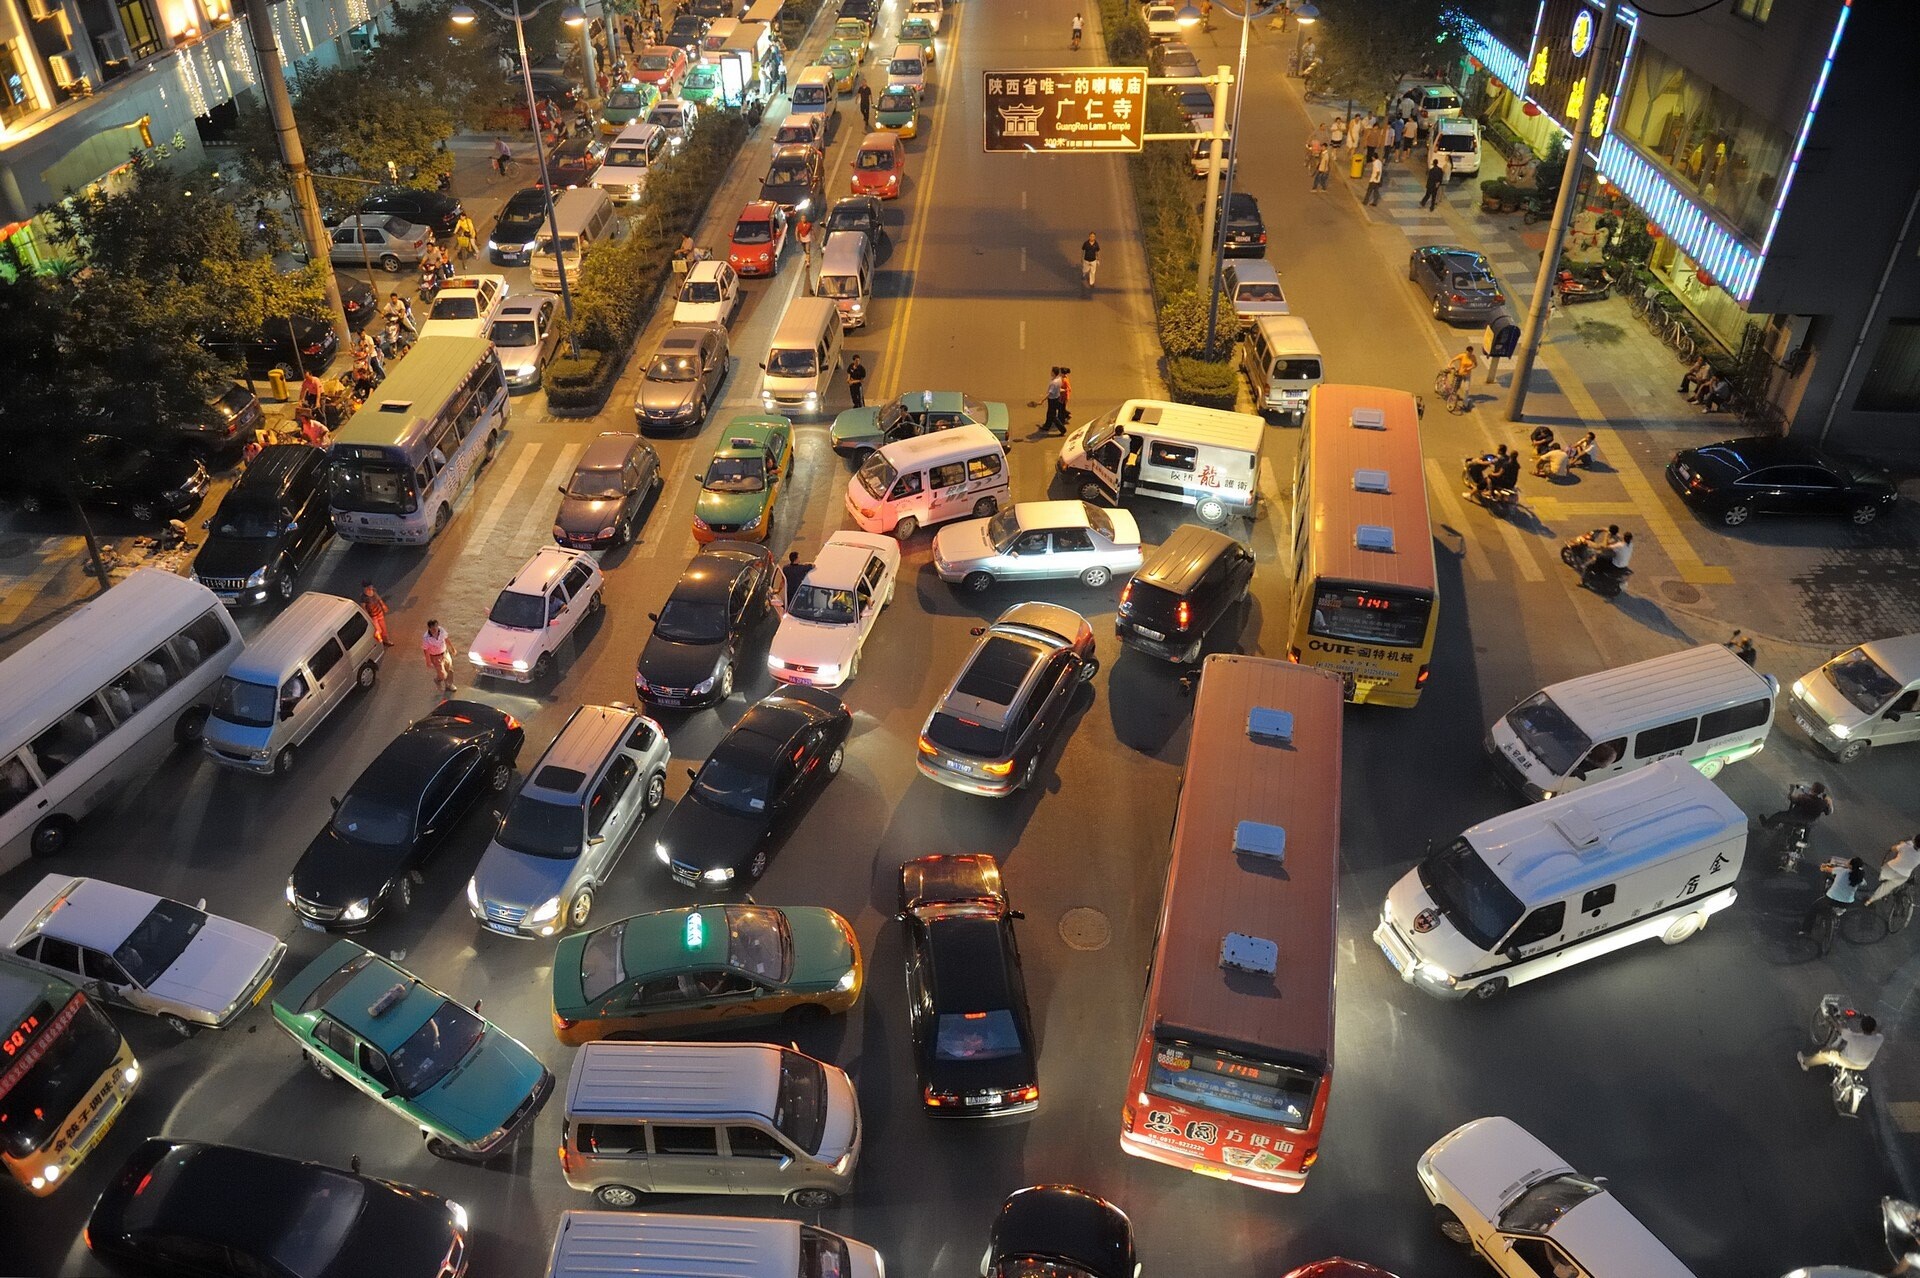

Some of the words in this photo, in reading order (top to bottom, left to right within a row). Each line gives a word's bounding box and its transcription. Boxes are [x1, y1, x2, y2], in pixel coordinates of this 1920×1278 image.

[988, 77, 1142, 95] 陕西省唯一的喇嘛庙
[1056, 98, 1133, 120] 广仁寺
[1055, 122, 1088, 132] GuangRen
[1089, 122, 1107, 131] Lama
[1107, 122, 1131, 131] Temple
[1224, 1128, 1296, 1154] 方便面
